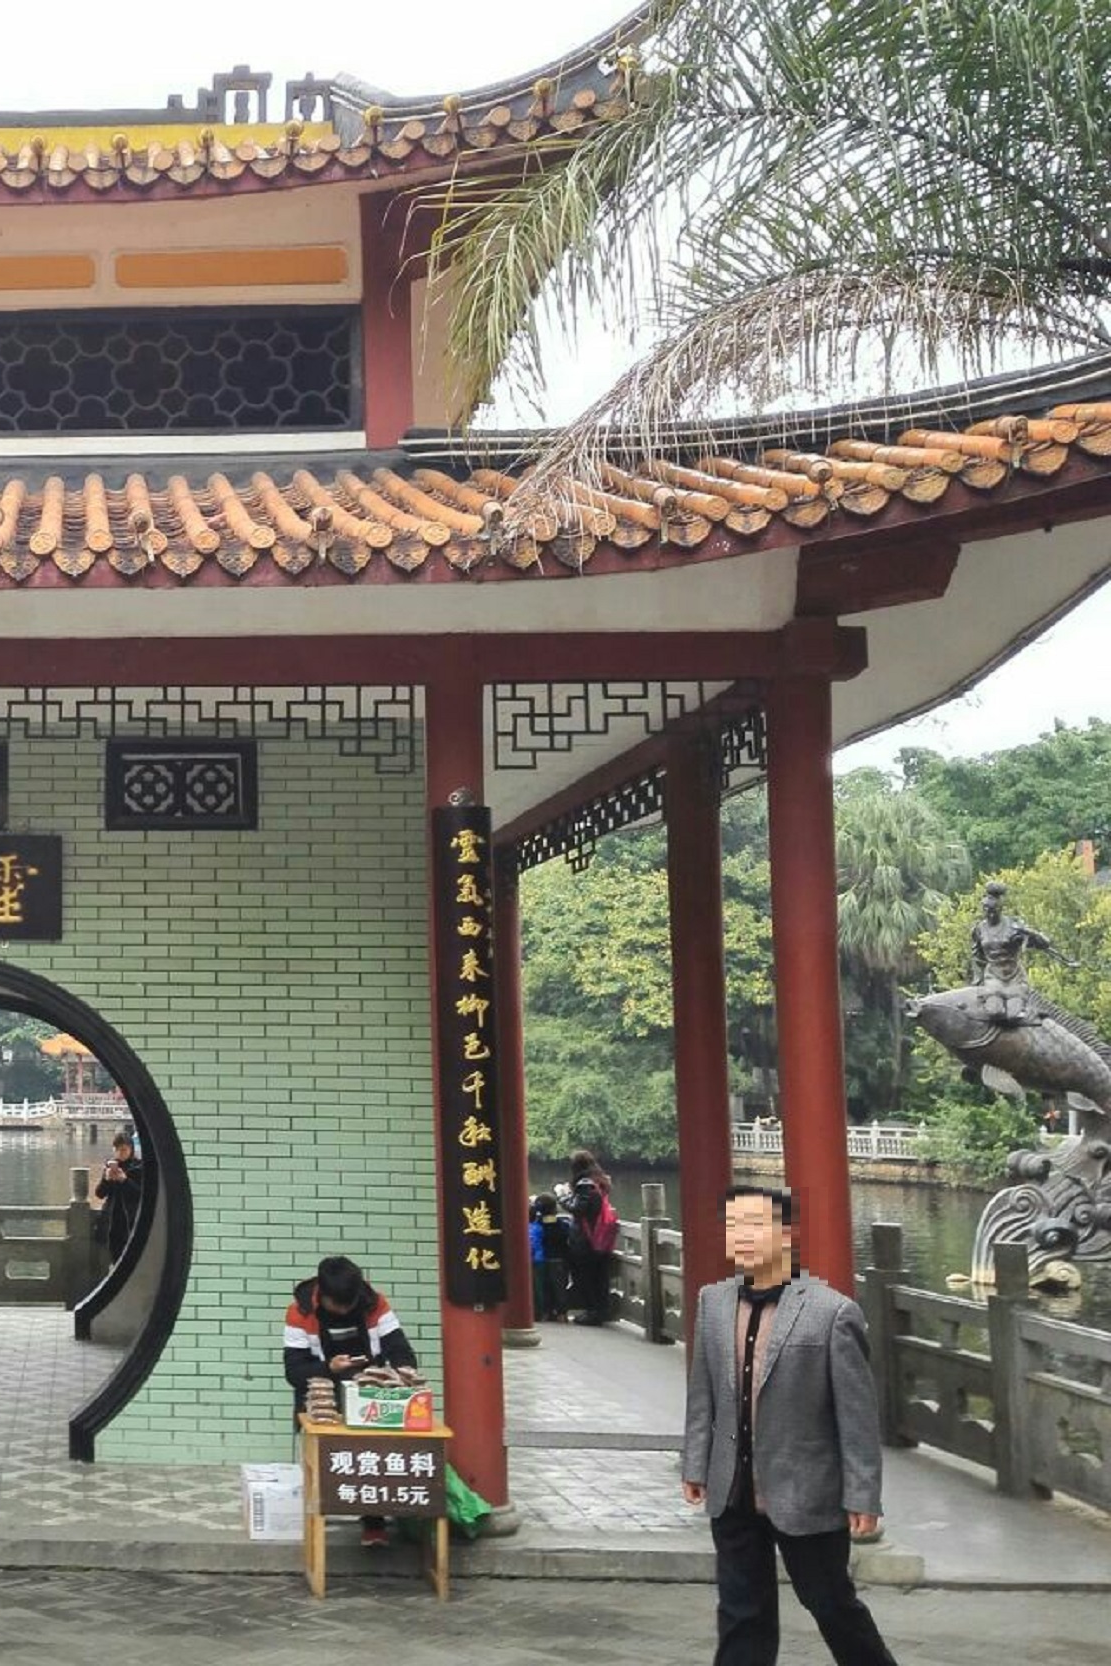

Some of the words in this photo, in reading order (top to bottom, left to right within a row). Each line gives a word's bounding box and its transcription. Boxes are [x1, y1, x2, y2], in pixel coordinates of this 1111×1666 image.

[329, 1450, 436, 1478] 观赏鱼料
[337, 1483, 430, 1506] 每包1.5元
